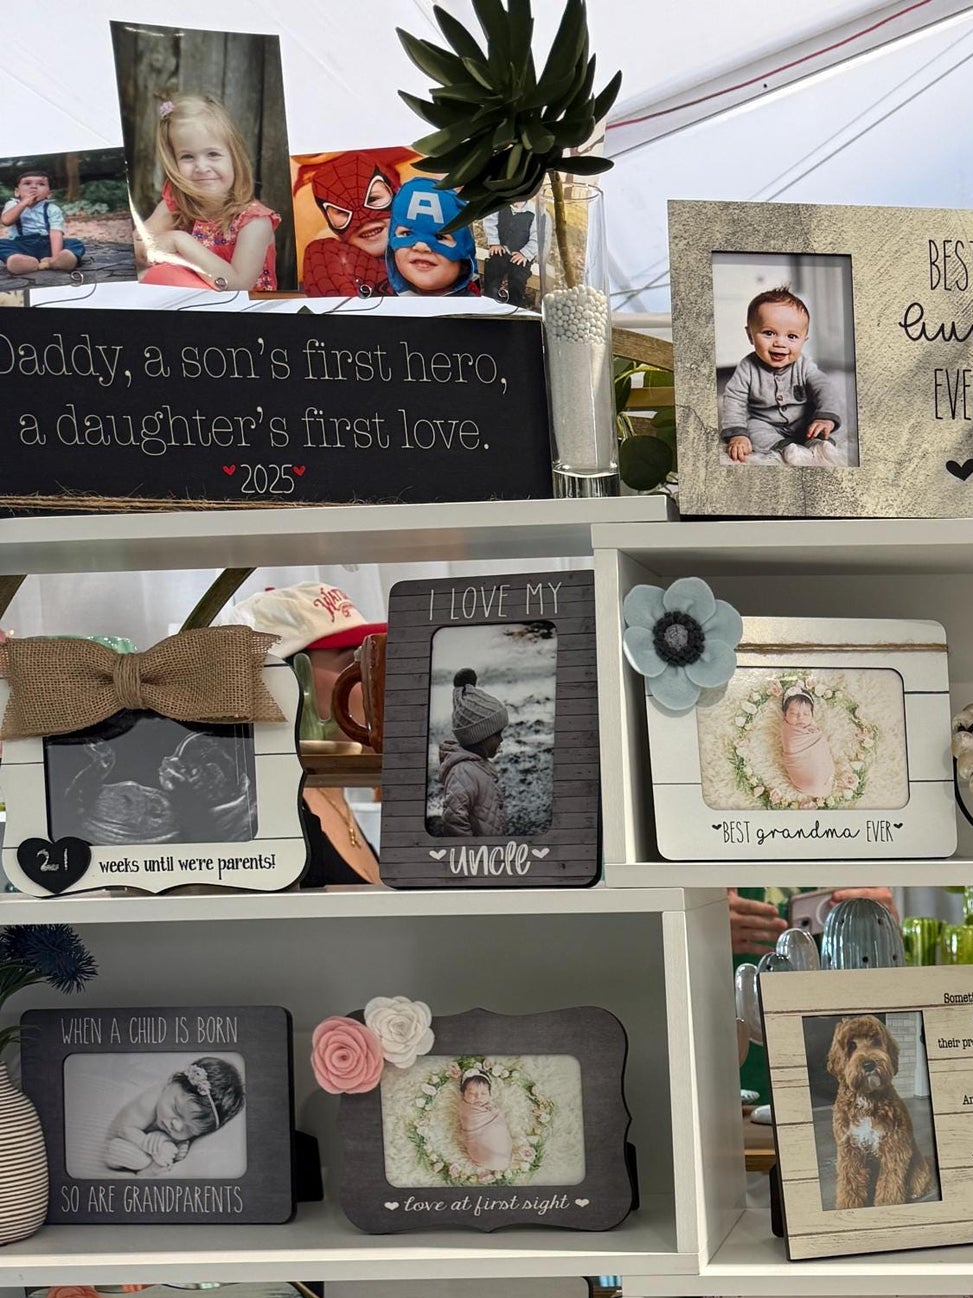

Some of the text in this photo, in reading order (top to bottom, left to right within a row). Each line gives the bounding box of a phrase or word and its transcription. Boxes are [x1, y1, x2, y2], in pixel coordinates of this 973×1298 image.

[407, 191, 444, 224] A
[145, 346, 171, 377] a
[181, 337, 291, 378] son's
[302, 339, 393, 380] first
[399, 340, 508, 395] hero,
[18, 403, 491, 456] a daughter's first love.
[240, 463, 296, 494] 2025
[429, 582, 563, 620] I LOVE MY
[722, 821, 895, 850] BEST grandma EVER
[99, 857, 139, 873] weeks
[143, 856, 174, 872] until
[218, 854, 276, 880] parents!
[450, 842, 531, 877] uncle
[61, 1016, 239, 1045] WHEN A CHILD IS BORN
[938, 1038, 960, 1049] their
[61, 1185, 244, 1214] SO ARE GRANDPARENTS
[404, 1194, 571, 1217] love at first sight
